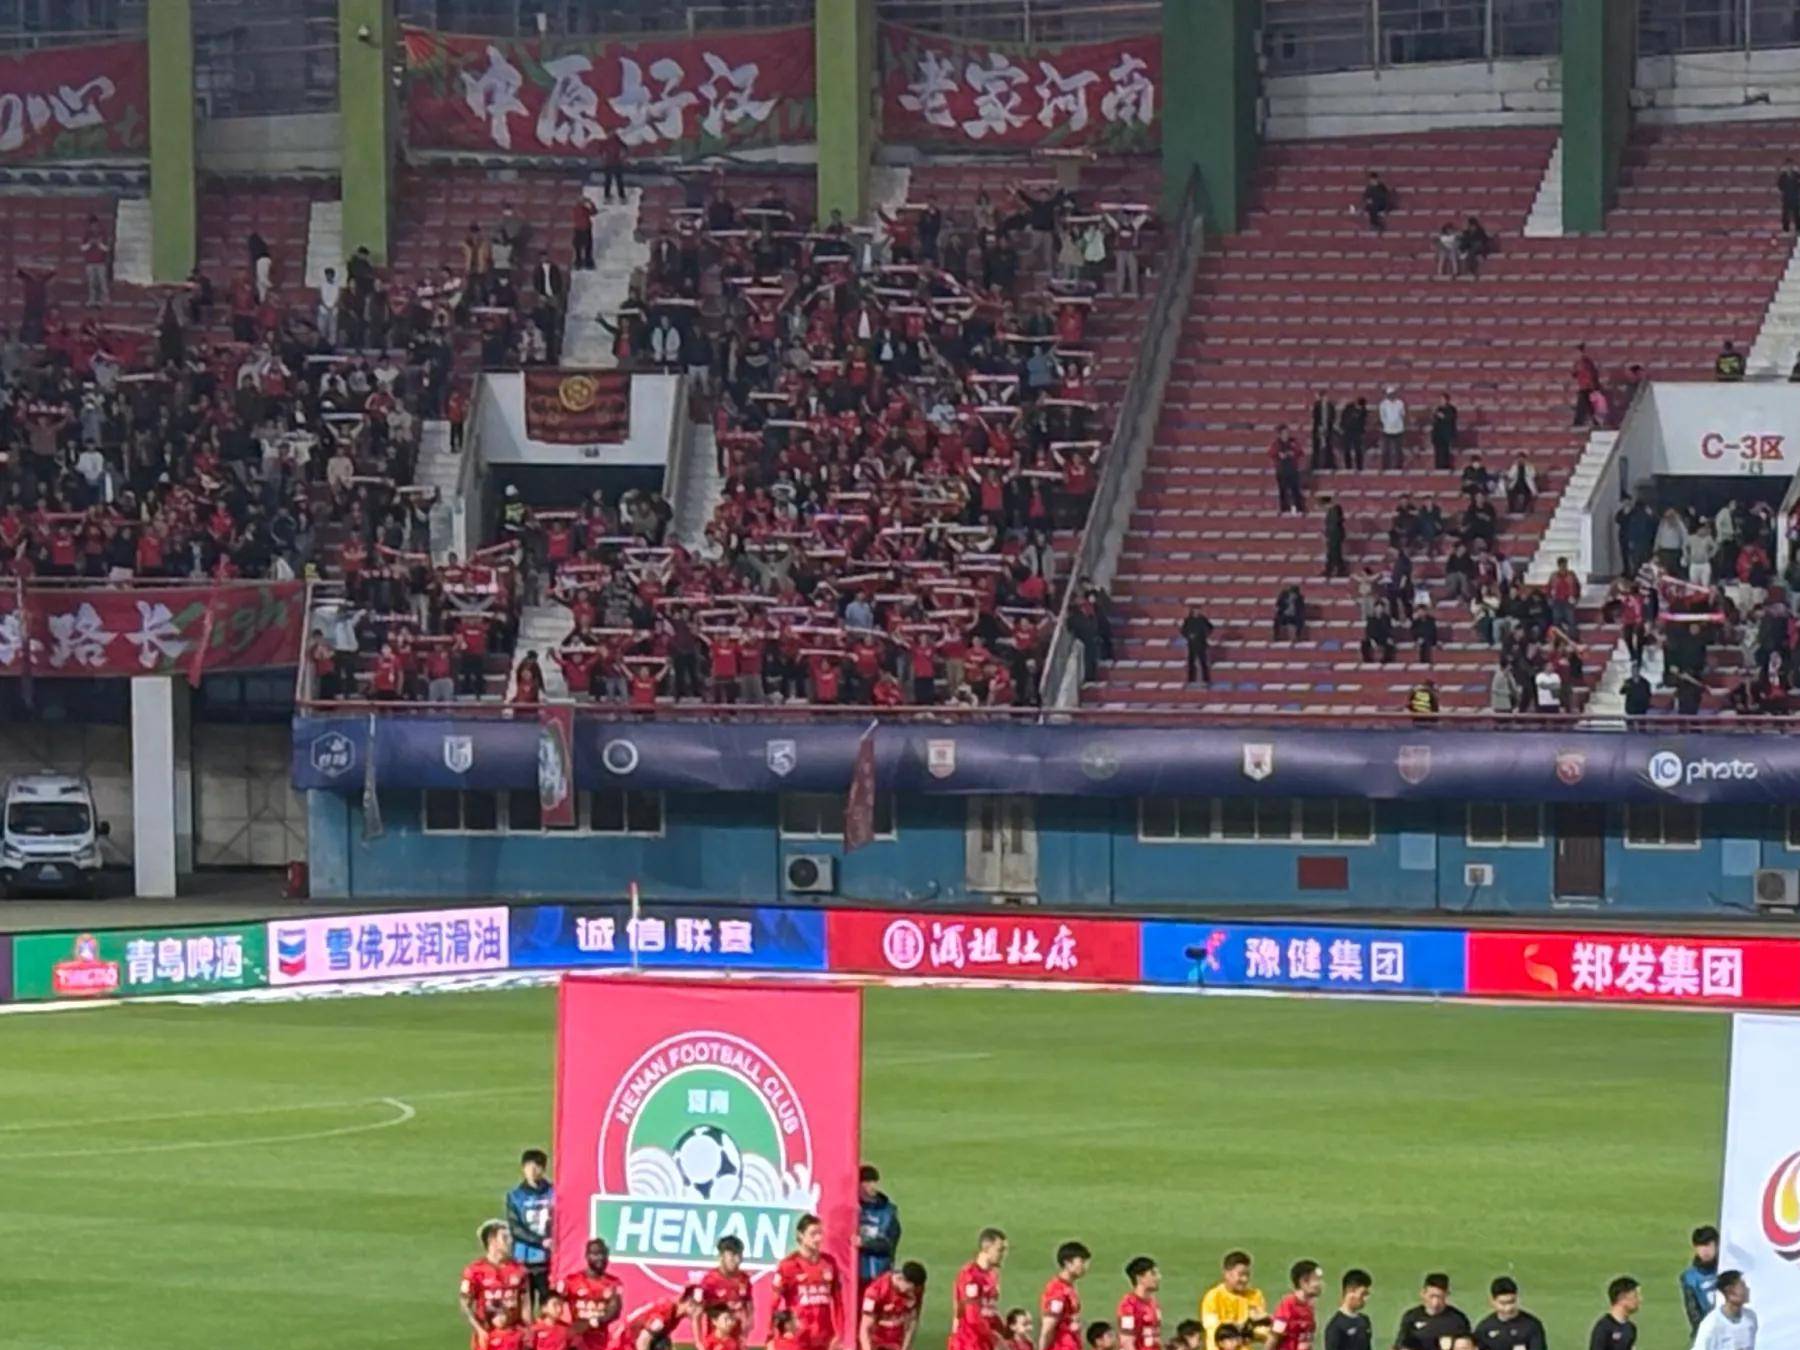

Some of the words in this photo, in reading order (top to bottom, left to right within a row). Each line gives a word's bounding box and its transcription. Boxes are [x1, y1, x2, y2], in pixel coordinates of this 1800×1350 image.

[900, 52, 1155, 138] 老家河南
[1702, 432, 1785, 460] C-3区
[1686, 758, 1758, 786] photo
[126, 936, 243, 983] 青岛啤酒
[326, 919, 500, 970] 雪佛龙润滑油
[576, 917, 753, 954] 诚信联赛
[1571, 940, 1743, 996] 郑发集团
[616, 1057, 668, 1124] HENAN
[669, 1042, 762, 1081] FOOTBALL
[763, 1076, 800, 1135] CLUB
[615, 1205, 791, 1259] HENAN
